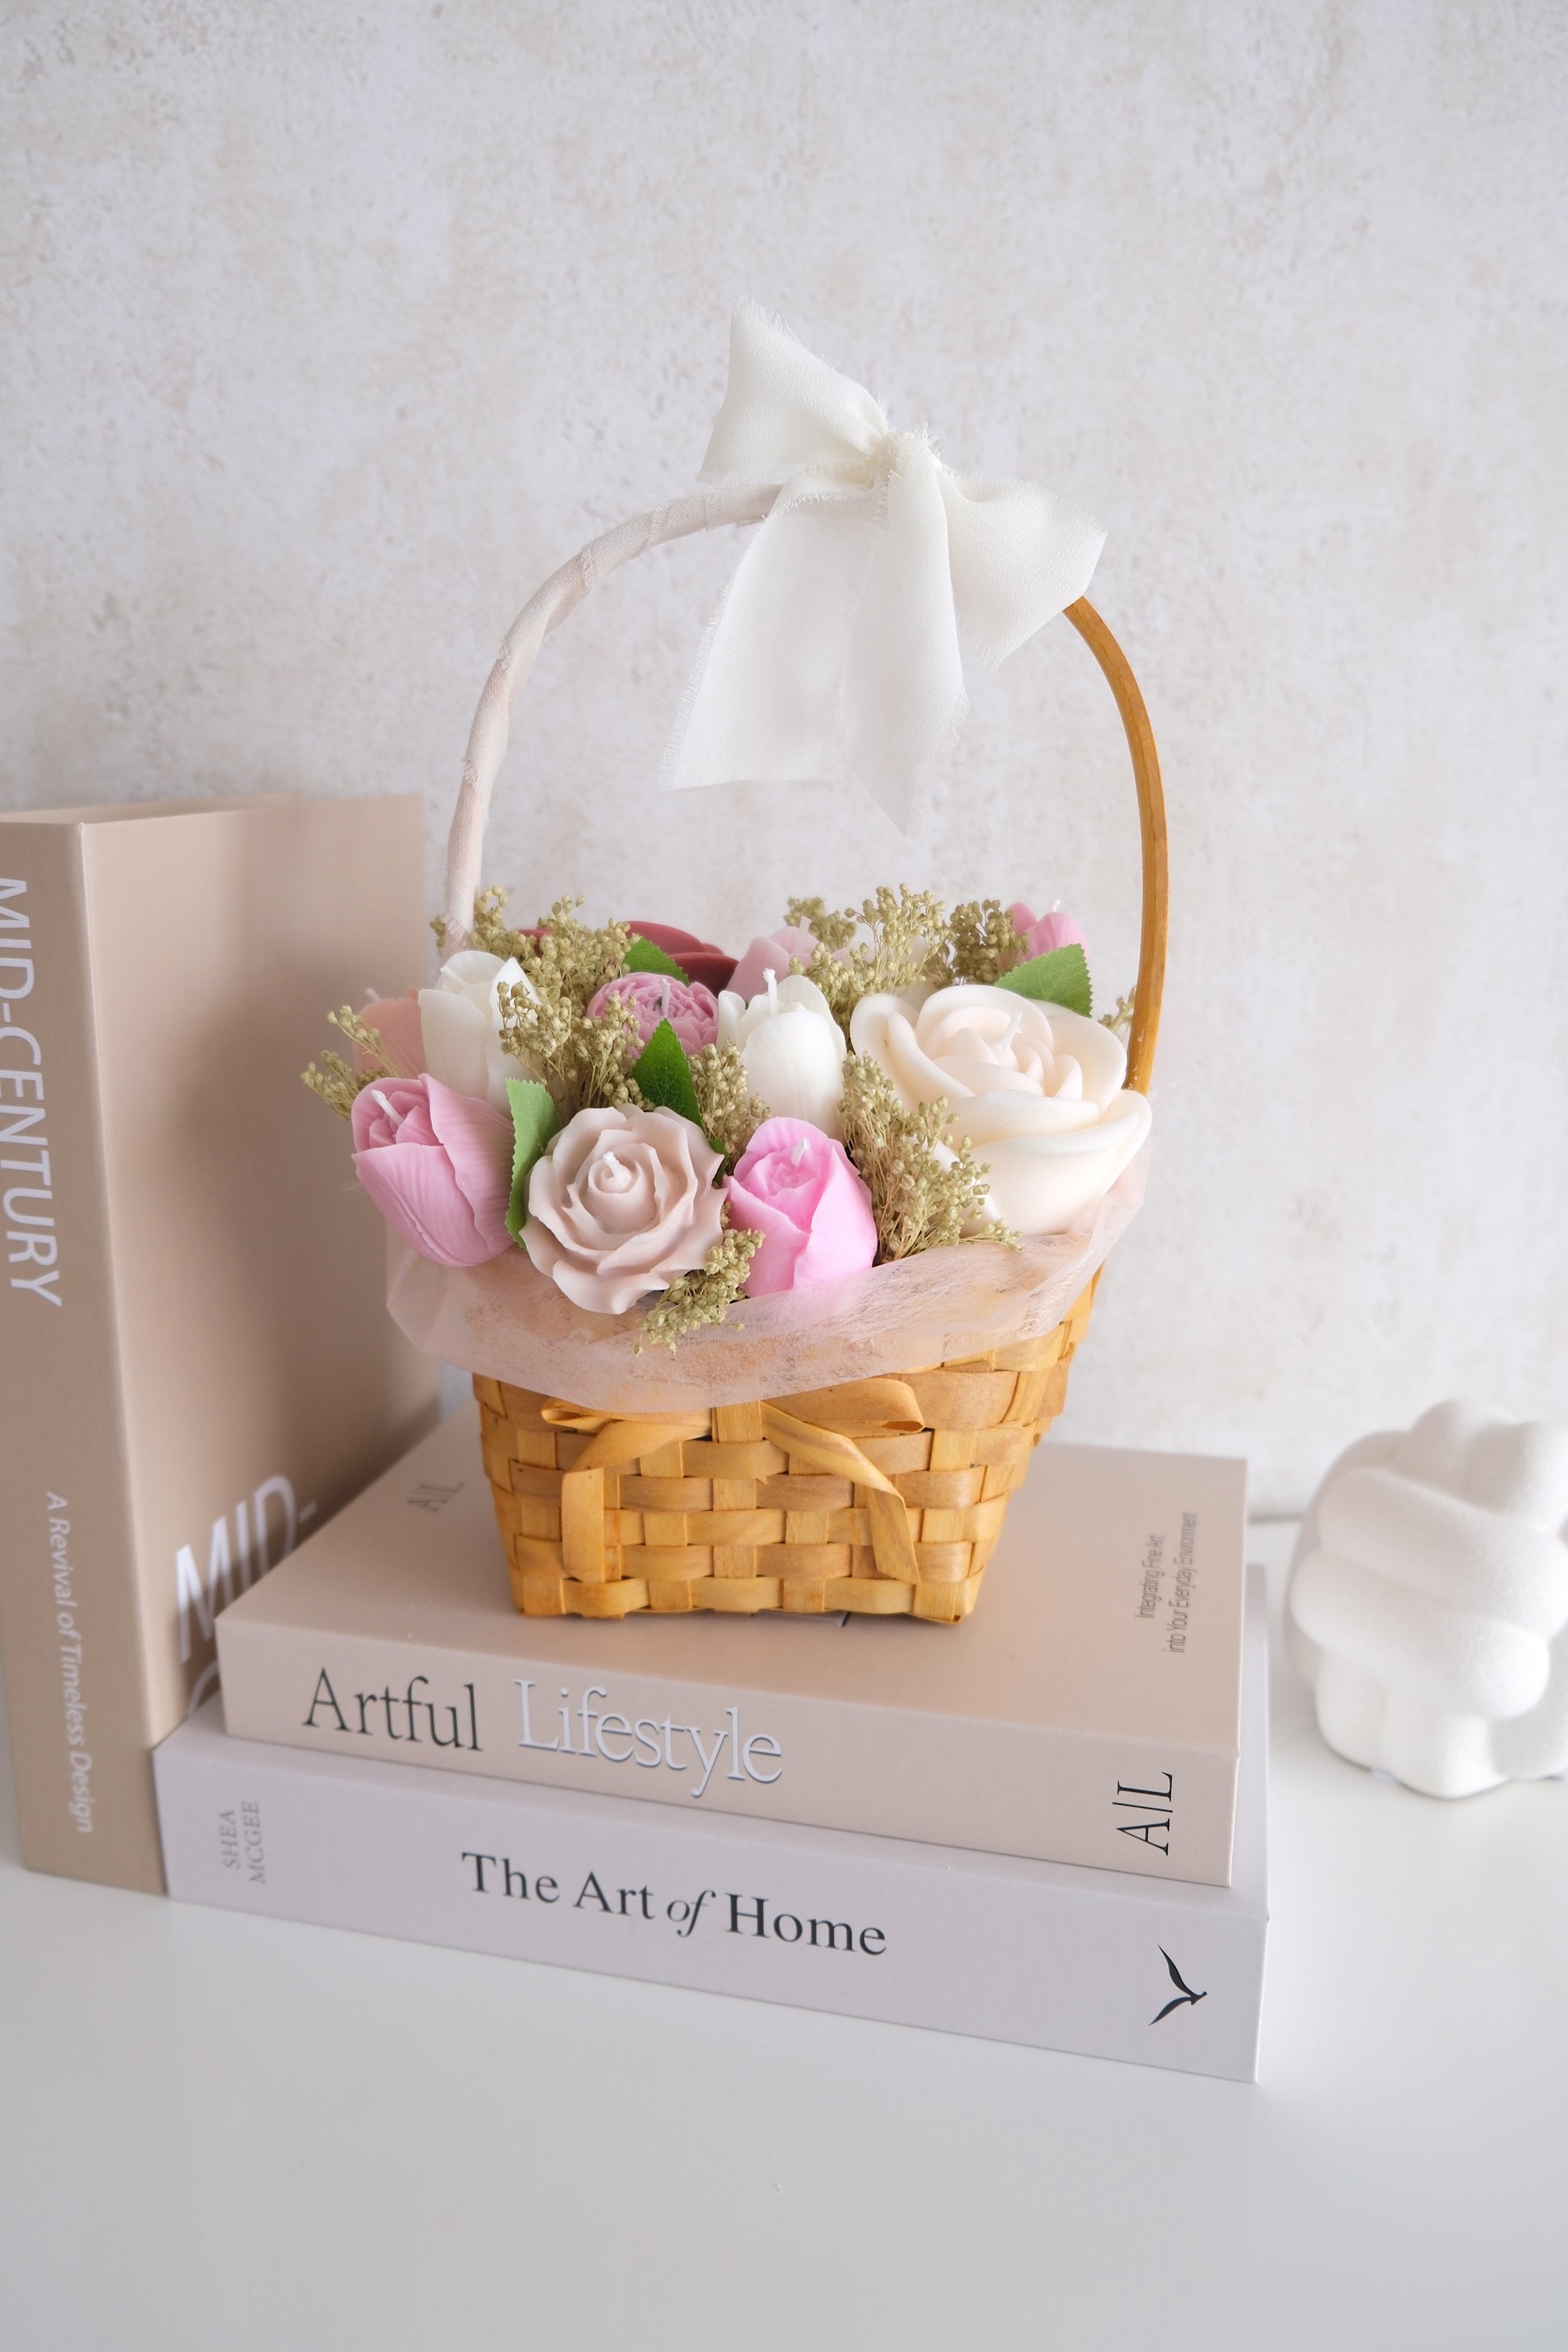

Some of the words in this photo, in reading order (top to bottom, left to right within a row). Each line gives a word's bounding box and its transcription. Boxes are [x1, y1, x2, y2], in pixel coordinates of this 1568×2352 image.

[0, 878, 62, 1307] MID-CENTURY
[46, 1491, 68, 1510] A
[49, 1518, 78, 1607] Revival
[1141, 1549, 1163, 1568] Fine
[1173, 1511, 1197, 1565] Environment
[1135, 1569, 1165, 1618] Integrating
[1169, 1567, 1197, 1608] Everyday
[57, 1612, 81, 1640] of
[1163, 1633, 1186, 1653] into
[1166, 1610, 1188, 1632] Your
[60, 1645, 88, 1745] Timeless
[302, 1667, 482, 1752] Artful
[514, 1679, 782, 1798] Lifestyle
[69, 1752, 95, 1832] Design
[218, 1809, 239, 1869] SHEA
[242, 1802, 267, 1884] MCGEE
[462, 1852, 560, 1904] The
[572, 1871, 656, 1921] Art
[666, 1889, 716, 1938] of
[725, 1893, 886, 1956] Home
